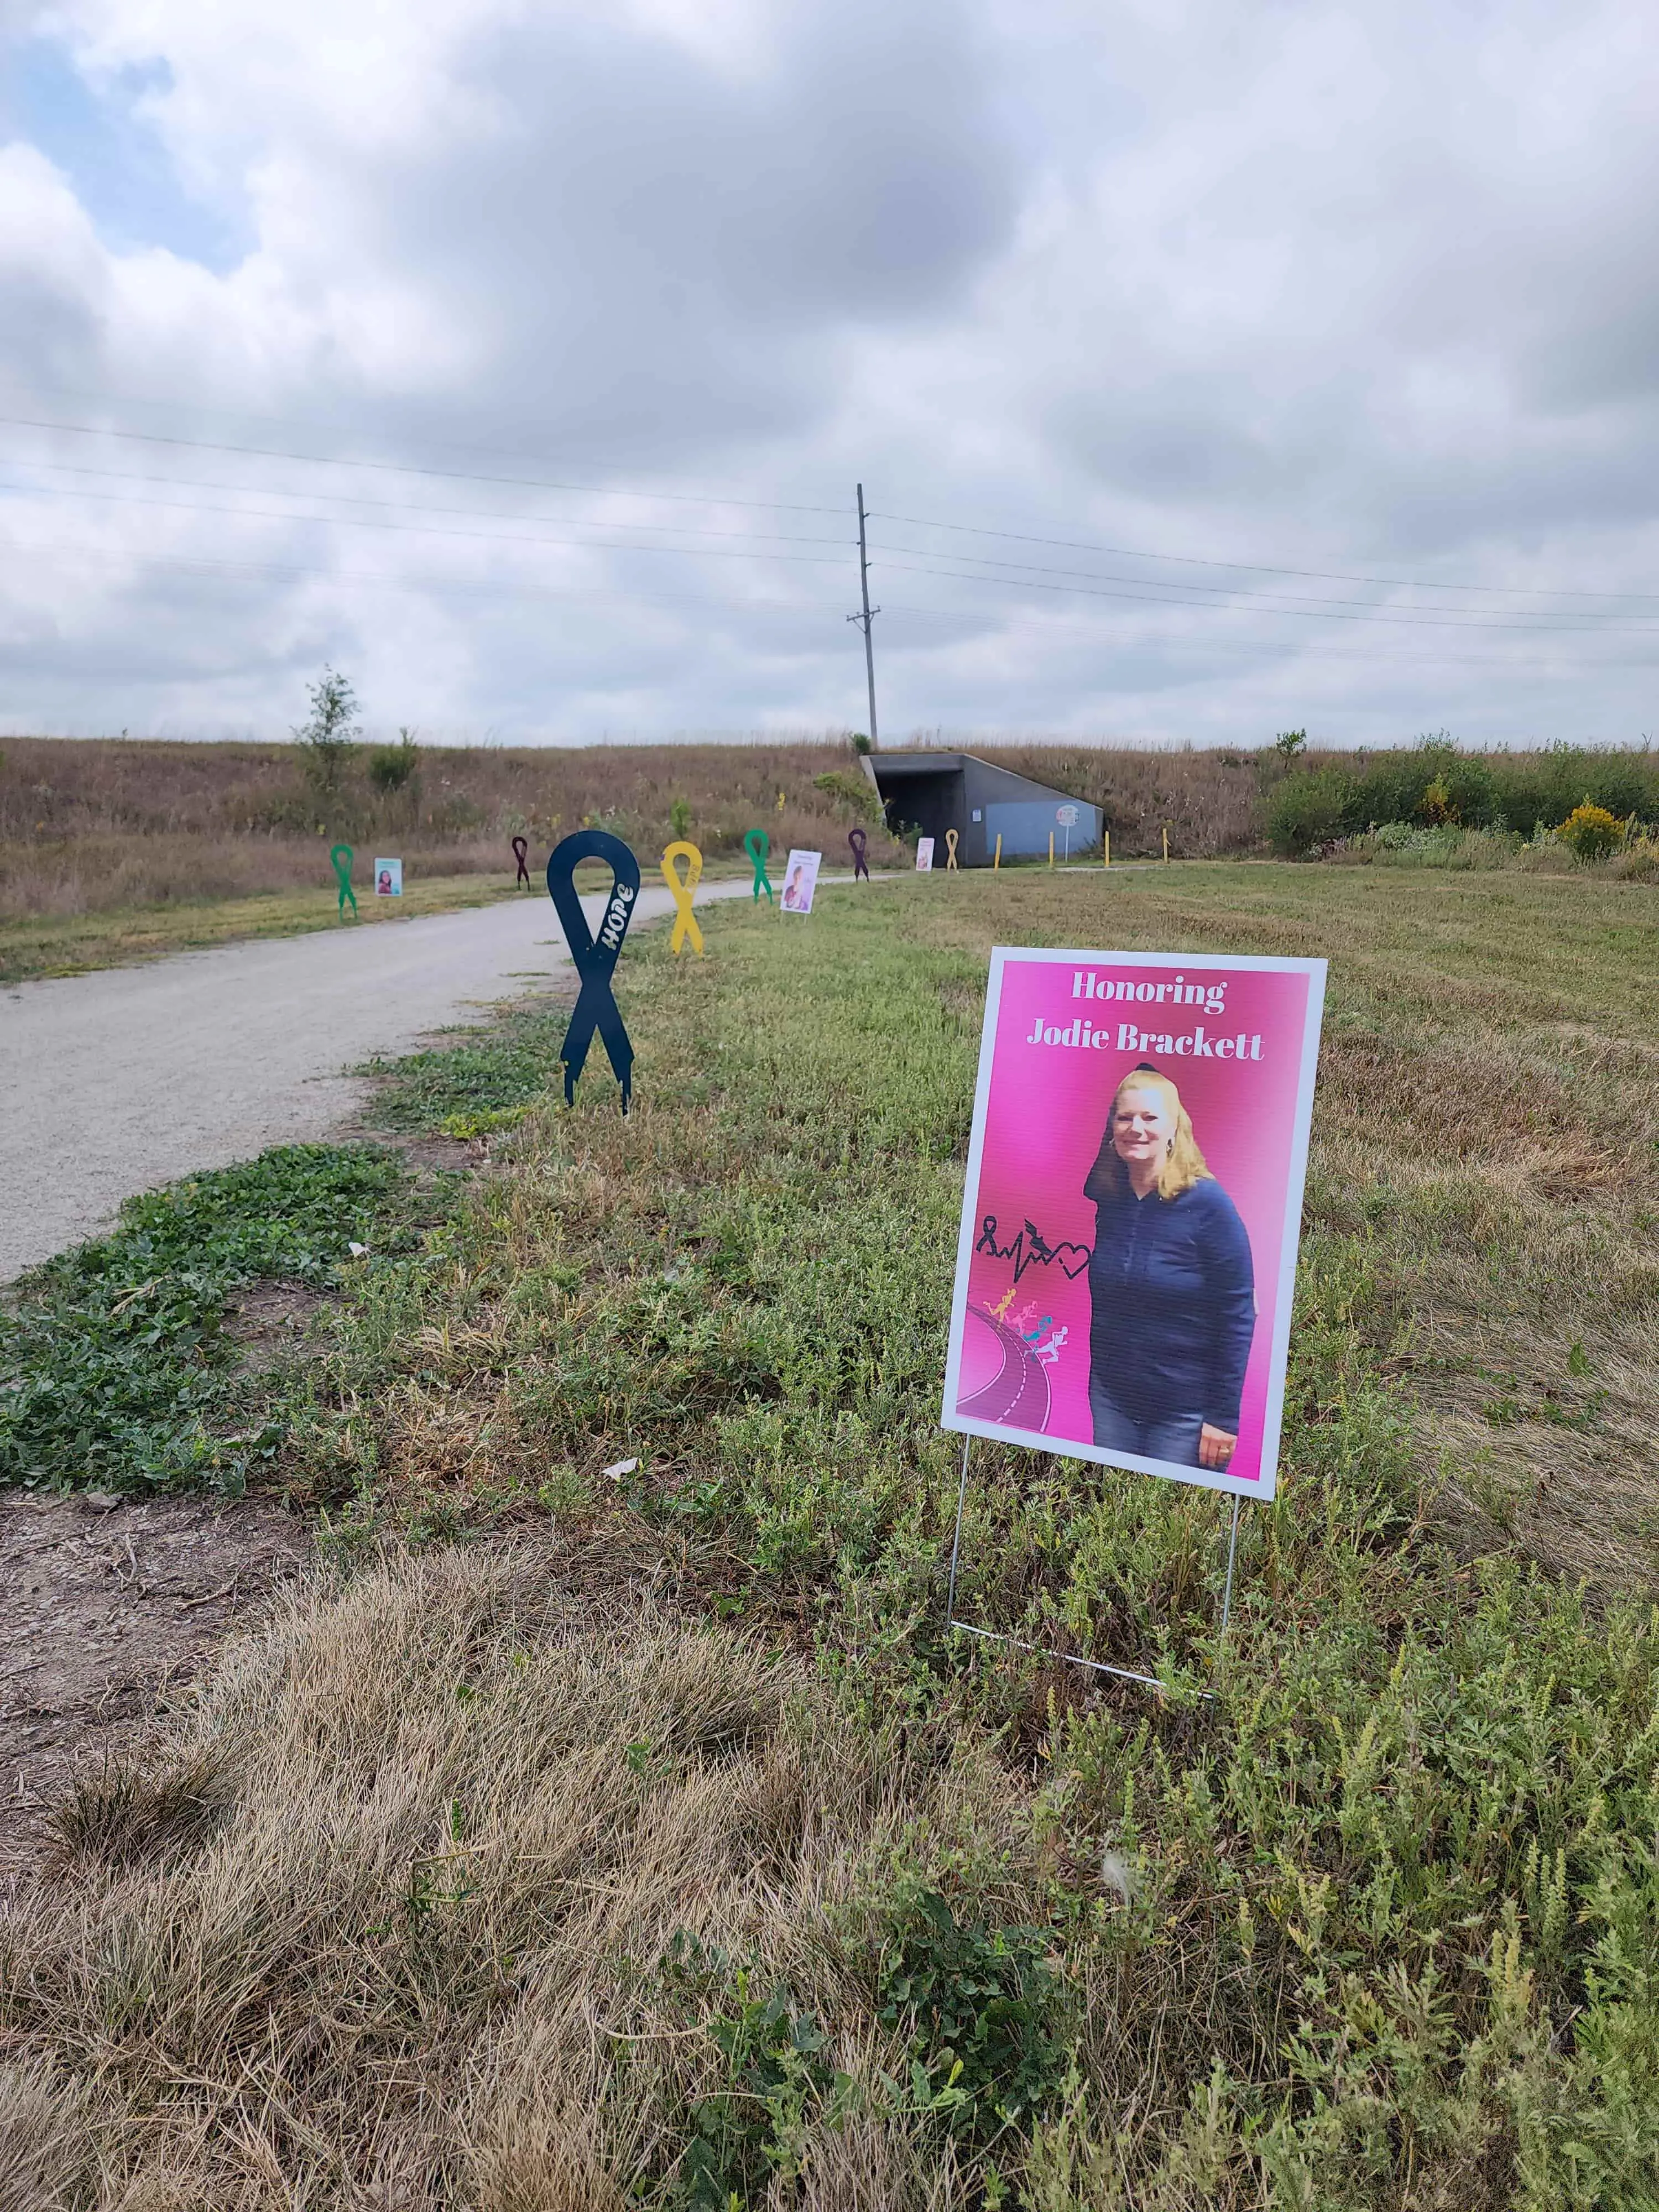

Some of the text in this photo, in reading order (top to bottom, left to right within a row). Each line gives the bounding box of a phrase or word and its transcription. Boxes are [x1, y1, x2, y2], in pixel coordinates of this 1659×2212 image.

[601, 883, 634, 951] HOPE
[1071, 972, 1228, 1015] Honoring
[1026, 1018, 1266, 1061] Jodie Brackett
